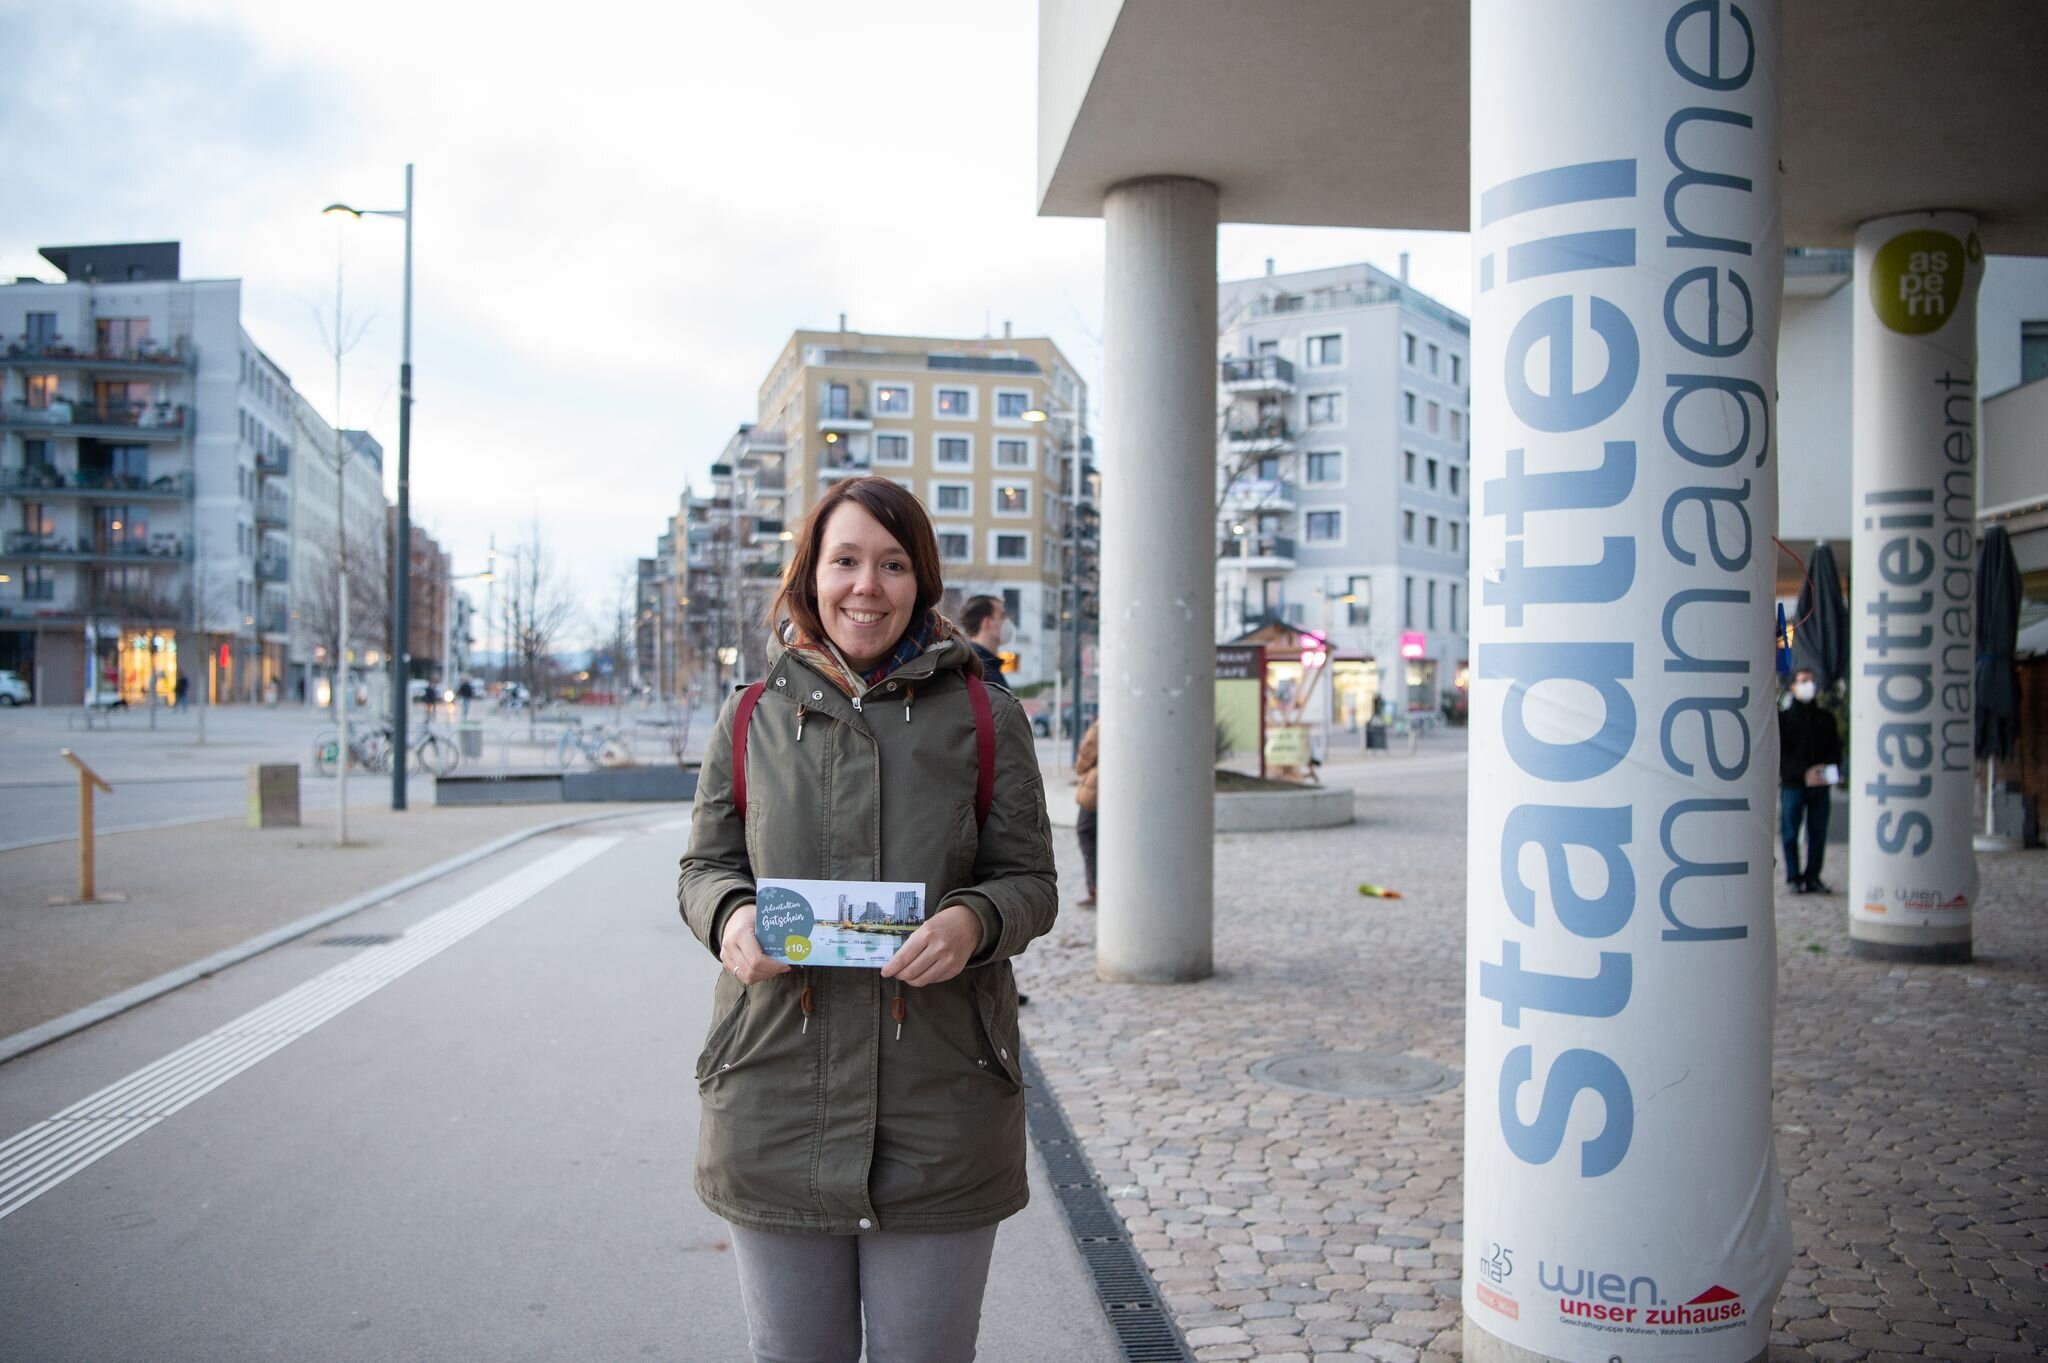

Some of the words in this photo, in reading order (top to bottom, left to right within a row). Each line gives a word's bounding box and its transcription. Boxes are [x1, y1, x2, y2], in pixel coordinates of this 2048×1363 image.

[1478, 158, 1641, 1178] stadtteil
[1863, 488, 1936, 858] stadtteil
[1934, 370, 1976, 773] management
[762, 911, 805, 931] Gutschein
[1560, 1298, 1638, 1323] unser
[1645, 1301, 1746, 1325] zuhause.
